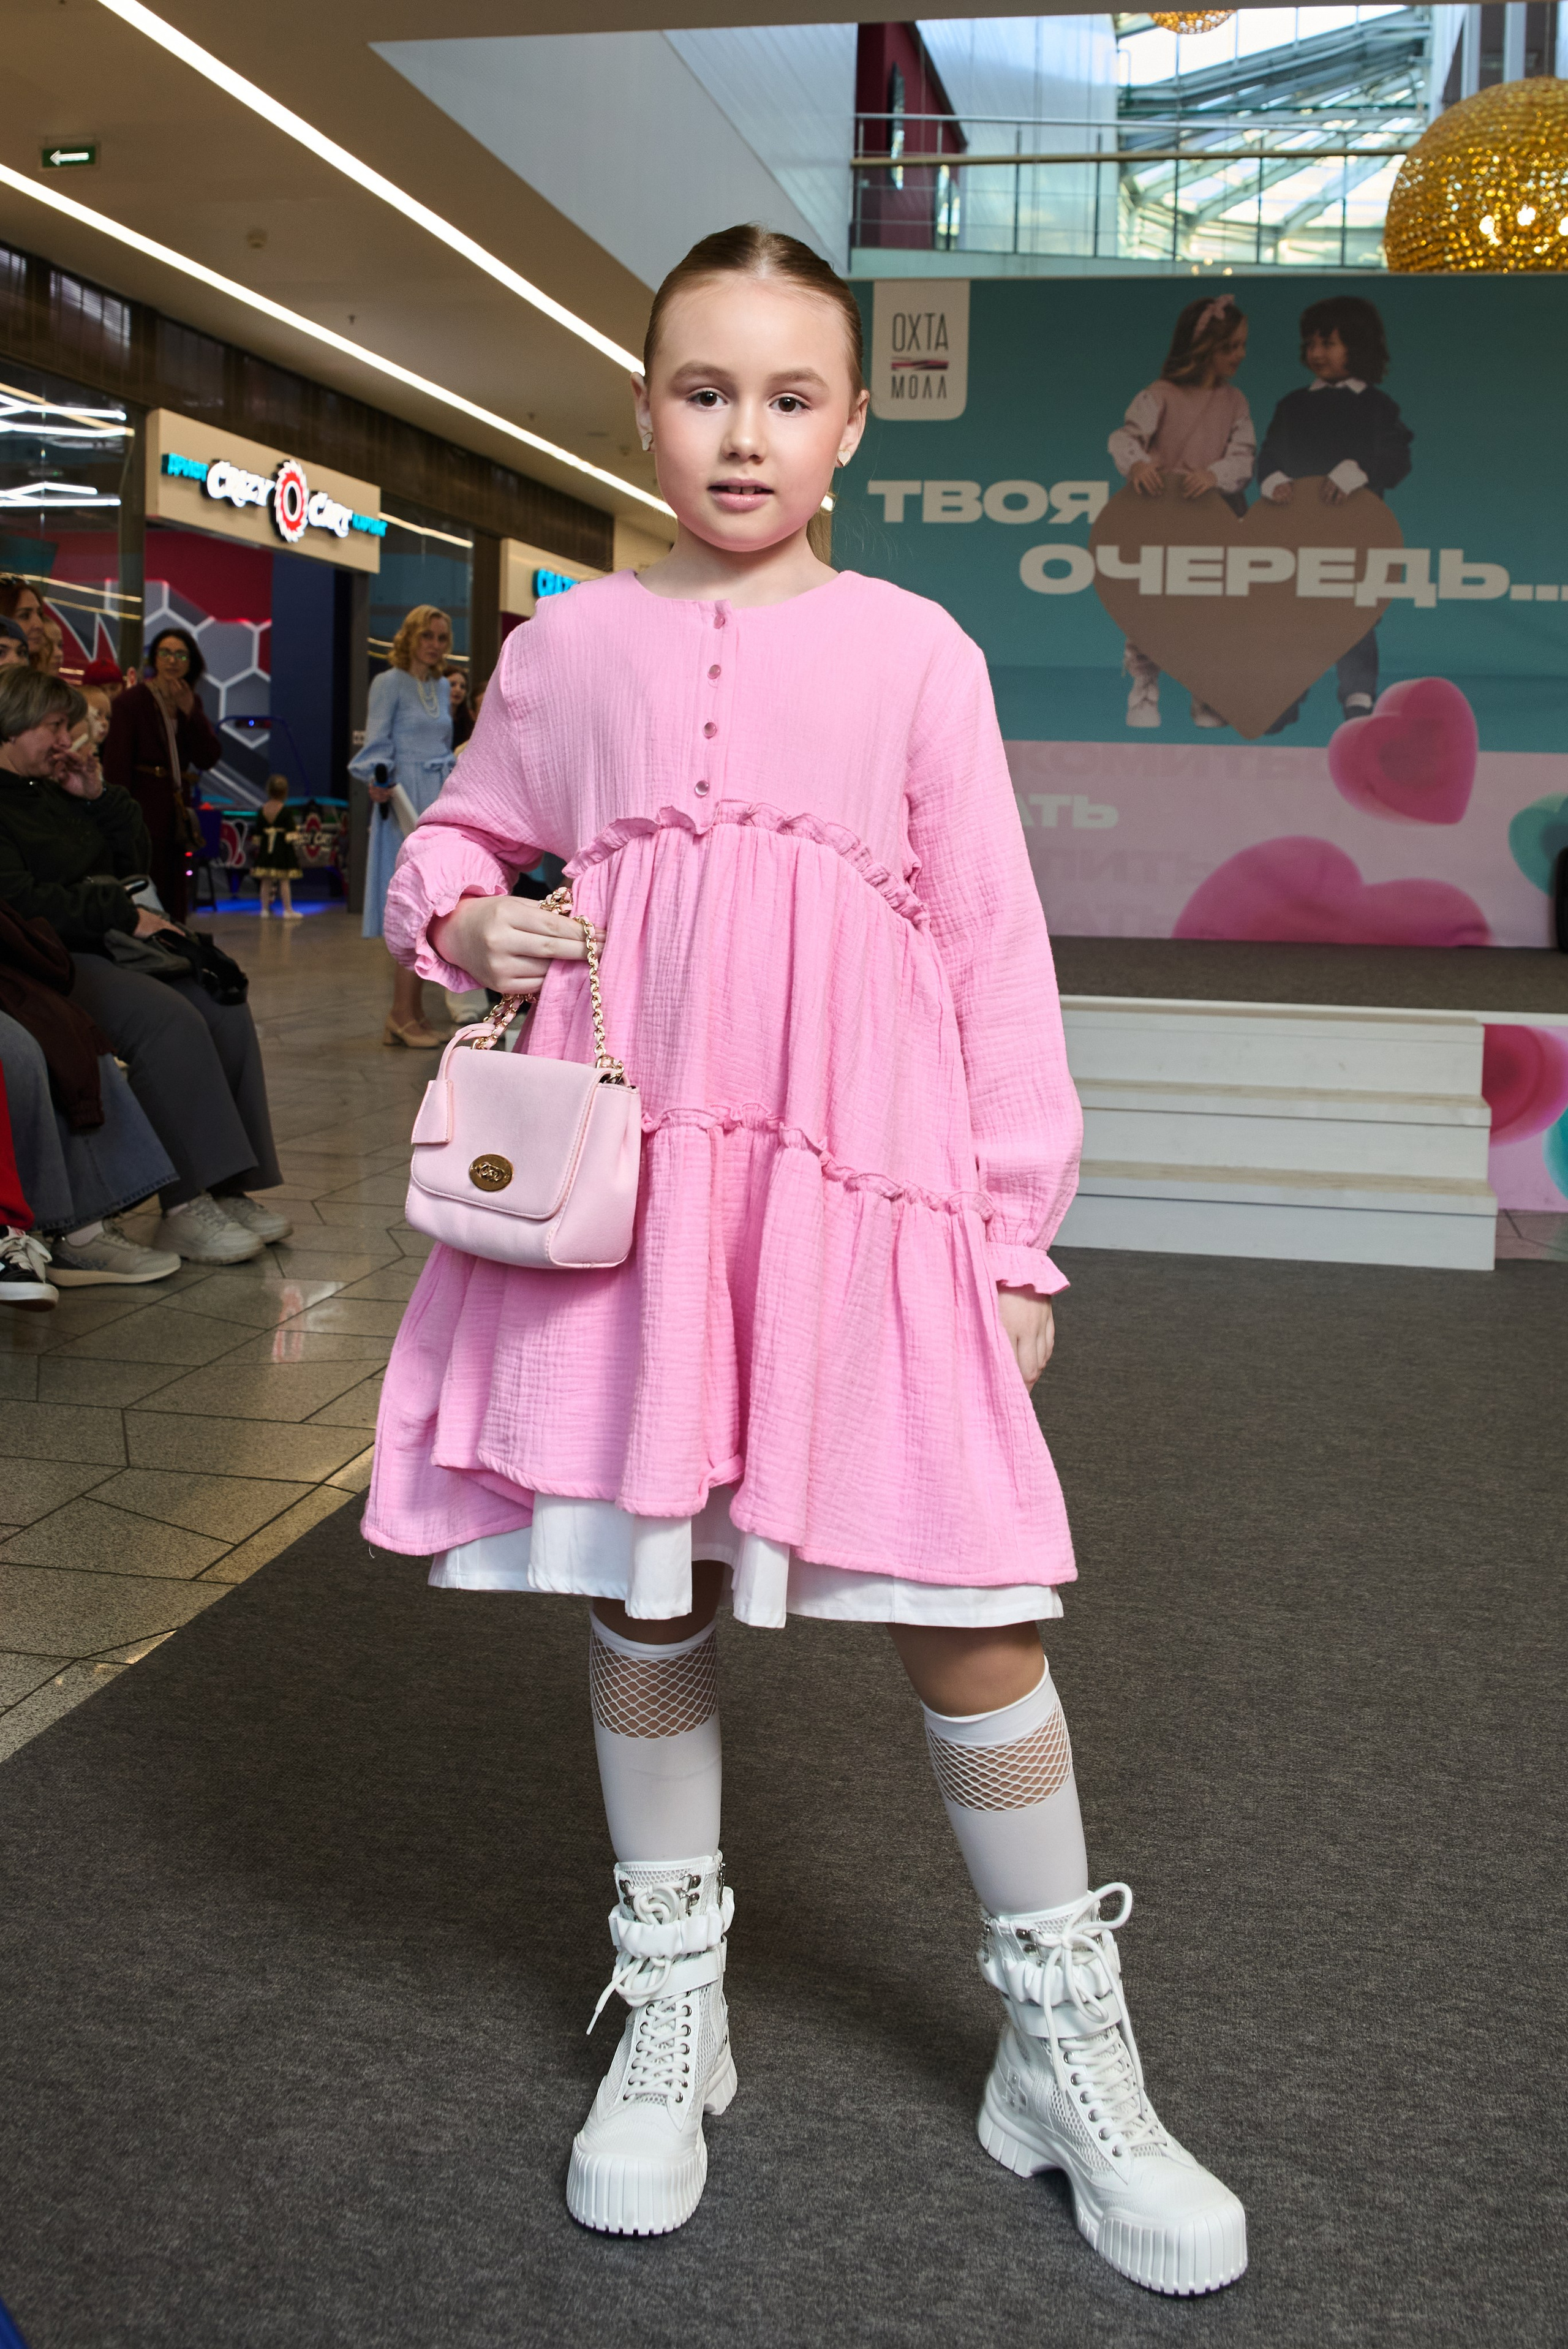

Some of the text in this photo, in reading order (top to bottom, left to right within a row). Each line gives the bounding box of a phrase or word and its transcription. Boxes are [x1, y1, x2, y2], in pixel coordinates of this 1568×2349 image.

[892, 312, 949, 352] ОХТА
[891, 374, 948, 399] МОЛЛ
[867, 480, 1110, 524] ТВОЯ
[1019, 543, 1568, 608] ОЧЕРЕДЬ..
